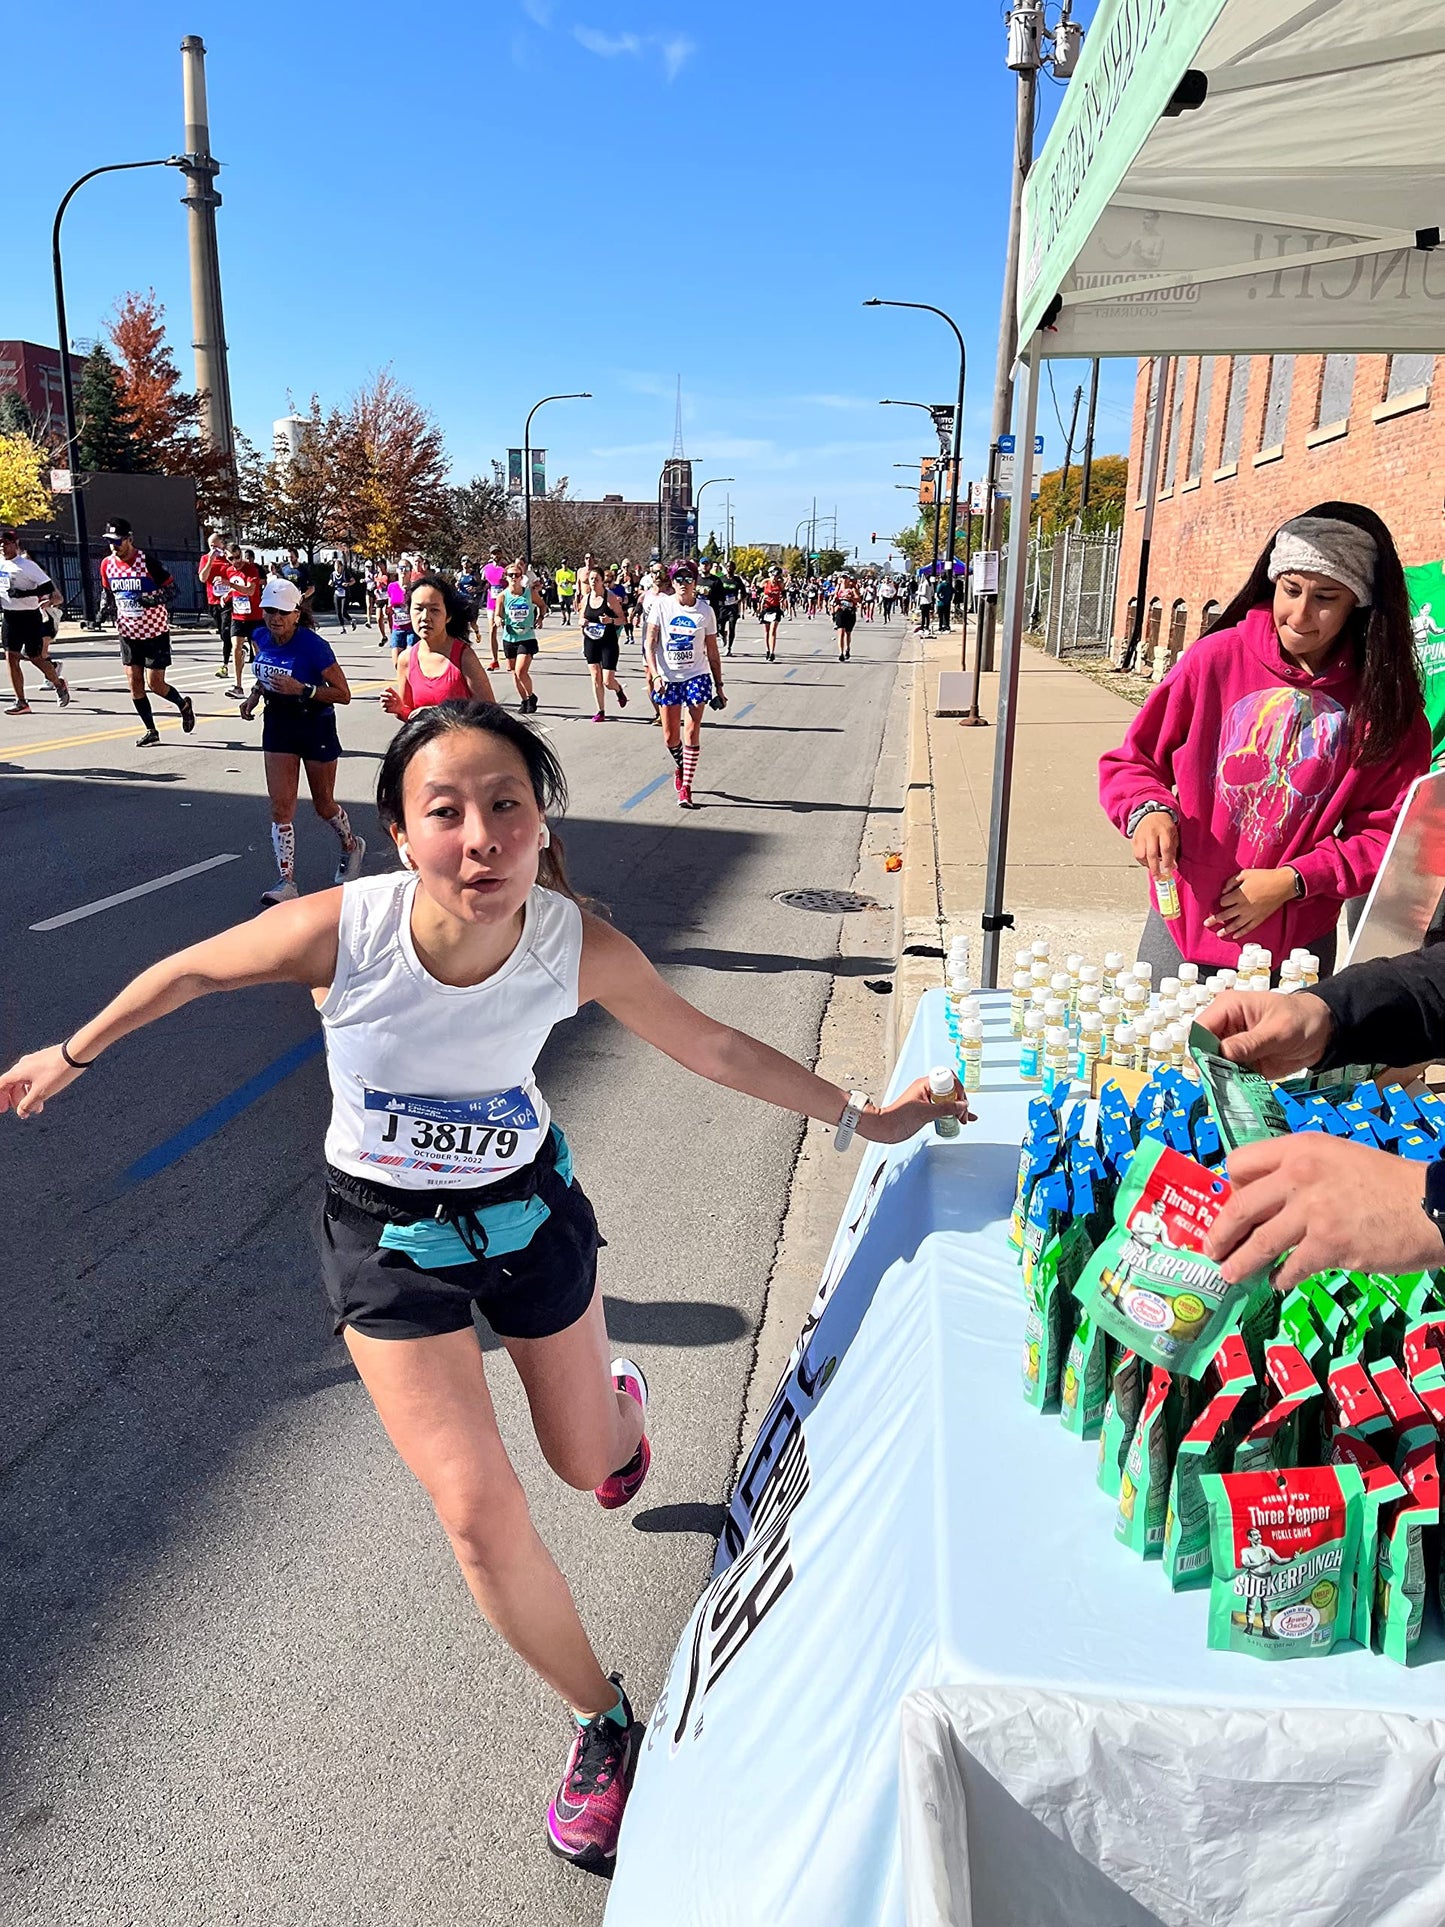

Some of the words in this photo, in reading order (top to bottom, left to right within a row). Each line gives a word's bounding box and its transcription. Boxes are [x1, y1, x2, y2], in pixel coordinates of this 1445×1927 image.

[110, 578, 142, 592] CROATIA
[408, 1105, 441, 1115] Chicago
[469, 1102, 482, 1112] Hi
[408, 1109, 449, 1120] Marathon
[381, 1114, 398, 1142] J
[411, 1120, 519, 1159] 38179
[414, 1149, 452, 1160] OCTOBER
[462, 1156, 483, 1164] 2022
[1160, 1184, 1197, 1217] Three
[1290, 1493, 1310, 1502] HOT
[1248, 1506, 1285, 1527] Three
[1287, 1504, 1331, 1526] Pepper
[1271, 1528, 1293, 1541] PICKLE
[1293, 1527, 1312, 1539] CHIPS
[1233, 1548, 1344, 1598] SUCKERPUNCH
[1285, 1614, 1309, 1624] Jewel
[1286, 1622, 1308, 1630] Osco
